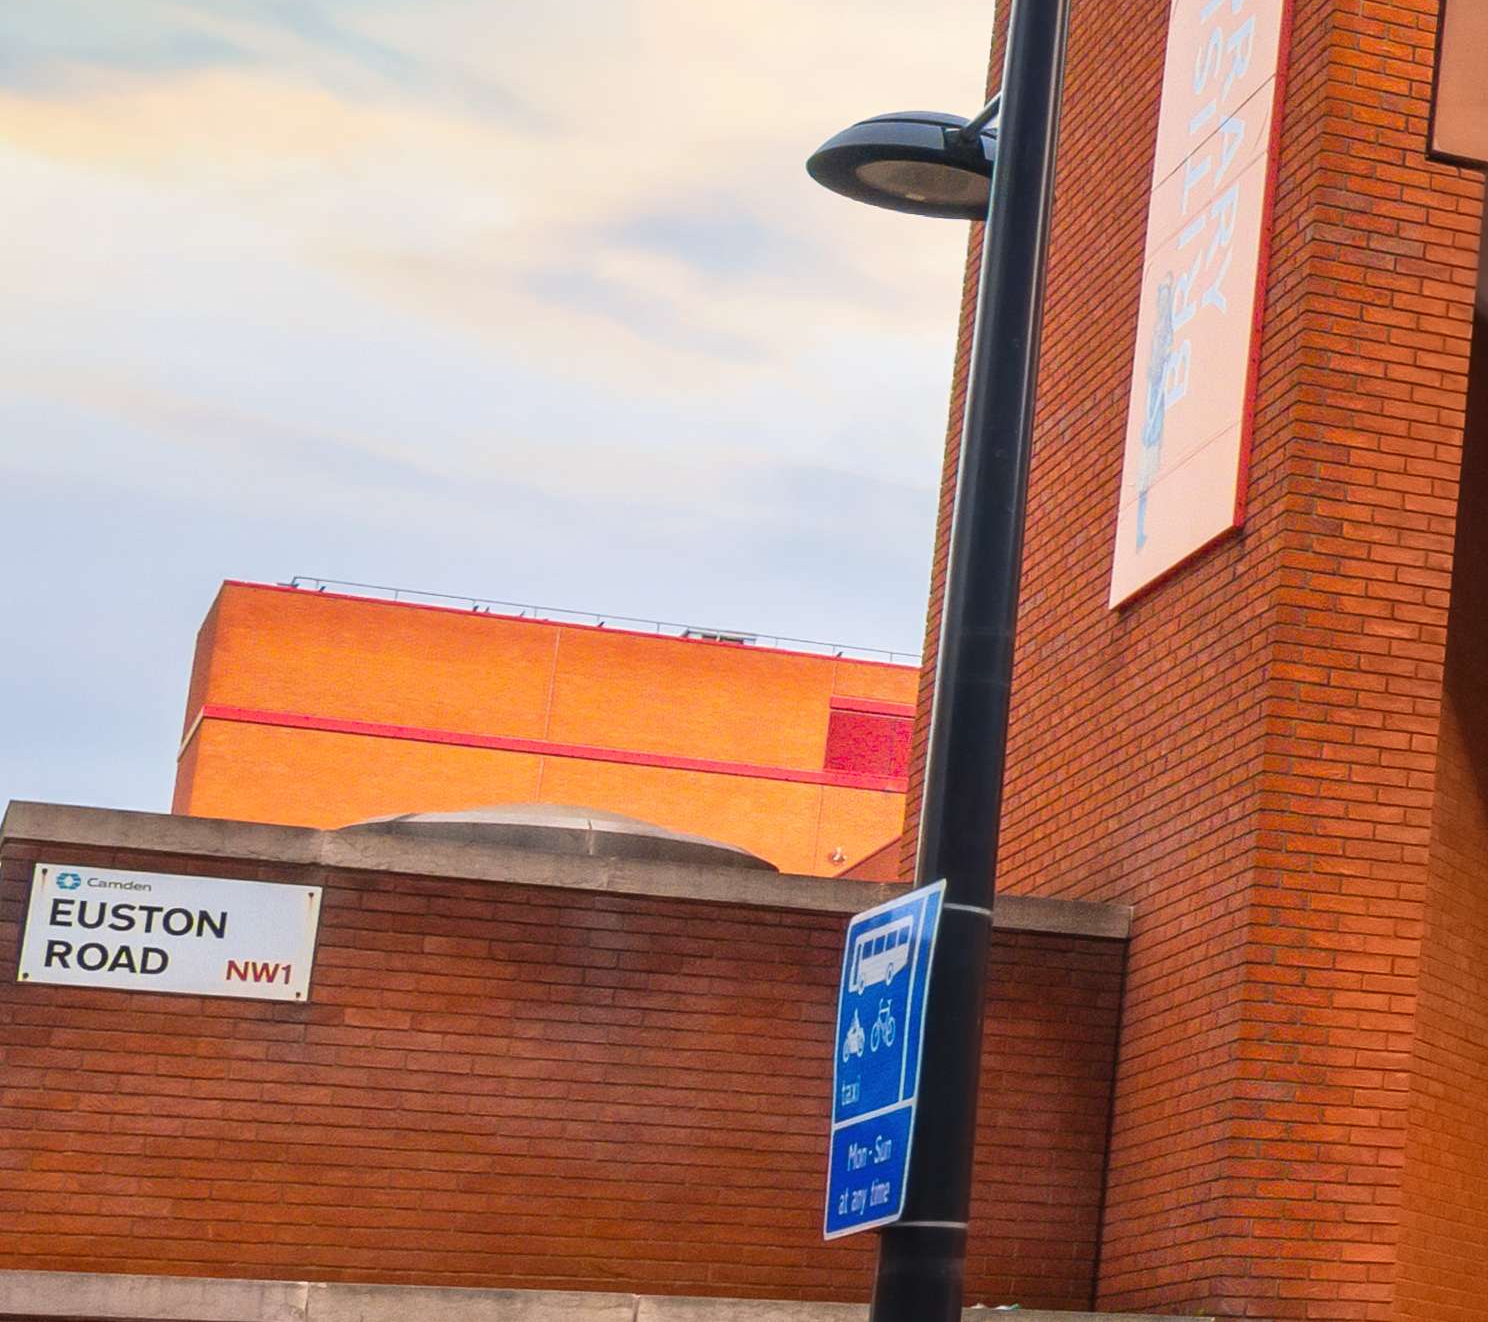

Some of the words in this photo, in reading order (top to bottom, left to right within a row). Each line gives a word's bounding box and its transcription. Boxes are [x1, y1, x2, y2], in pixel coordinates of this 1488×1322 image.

[87, 877, 152, 892] Camden
[49, 897, 228, 939] EUSTON
[44, 939, 170, 975] ROAD
[225, 959, 293, 985] NW1
[874, 1134, 892, 1165] Sun
[838, 1187, 849, 1216] at
[850, 1188, 868, 1216] any
[869, 1178, 891, 1207] time
